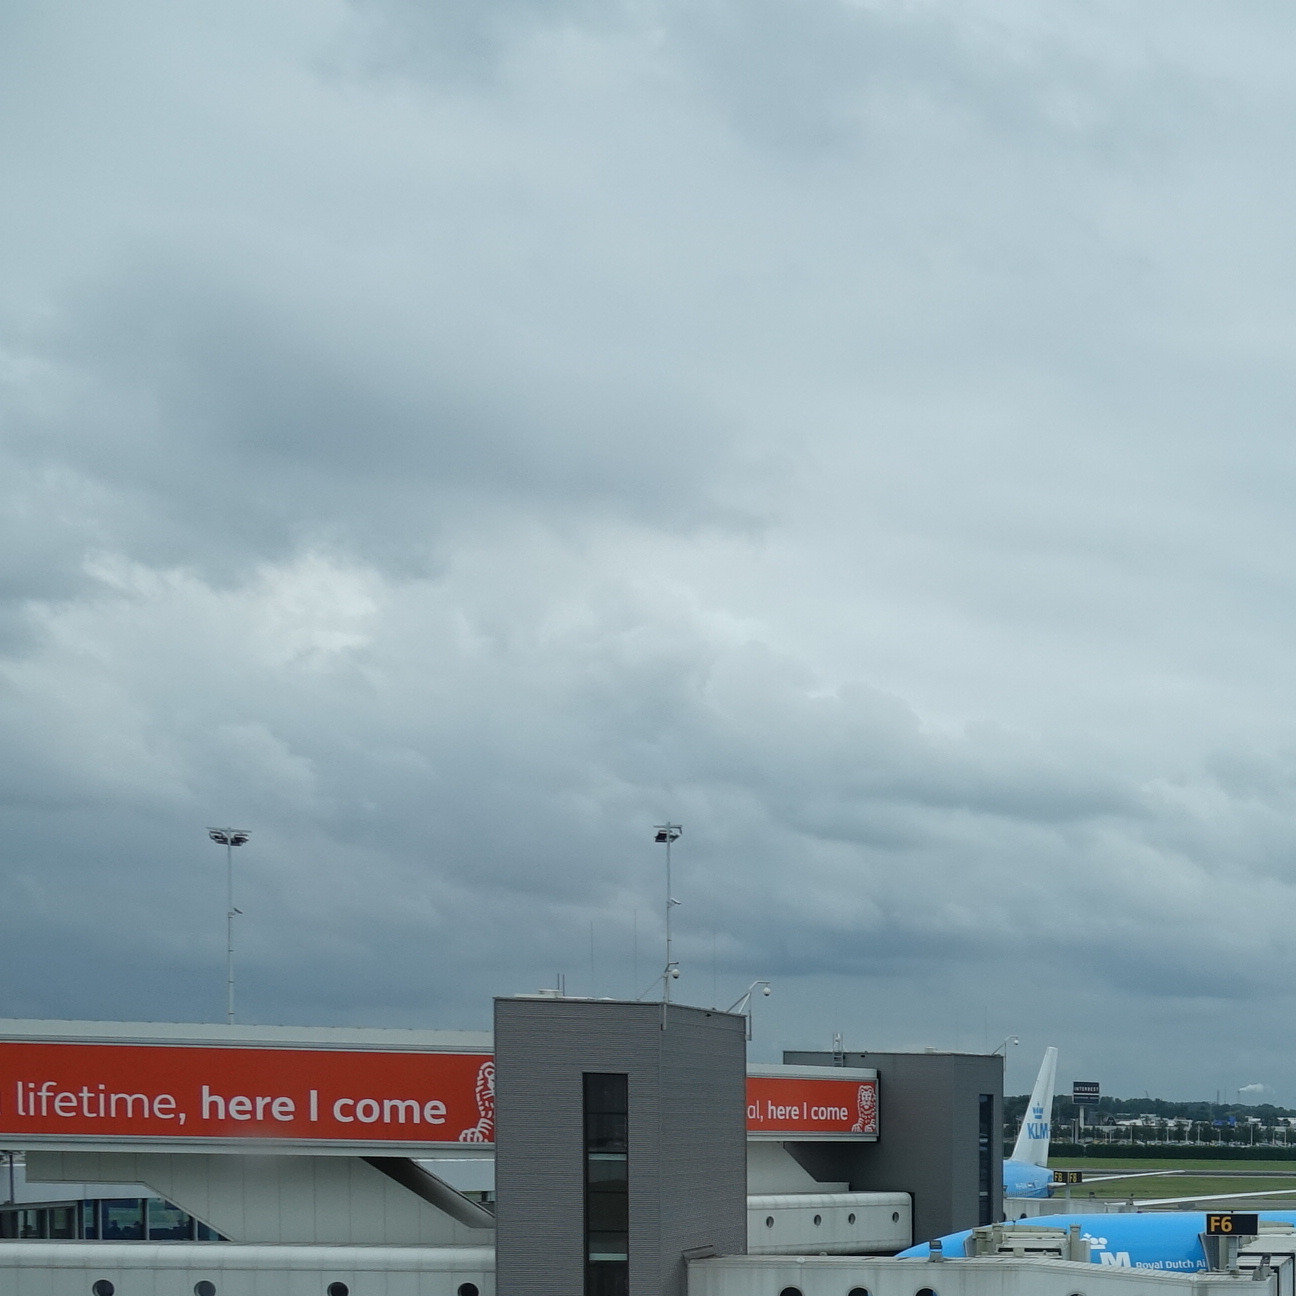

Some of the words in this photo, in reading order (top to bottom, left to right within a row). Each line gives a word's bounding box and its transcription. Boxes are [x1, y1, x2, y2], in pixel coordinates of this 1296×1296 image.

[16, 1081, 186, 1125] lifetime,
[201, 1086, 294, 1122] here
[309, 1090, 318, 1122] I
[333, 1097, 446, 1125] come
[768, 1101, 799, 1120] here
[803, 1102, 807, 1120] I
[811, 1106, 848, 1120] come
[1027, 1122, 1049, 1139] KLM
[1210, 1216, 1232, 1232] F6
[1135, 1261, 1163, 1270] Royal
[1166, 1260, 1194, 1269] Dutch
